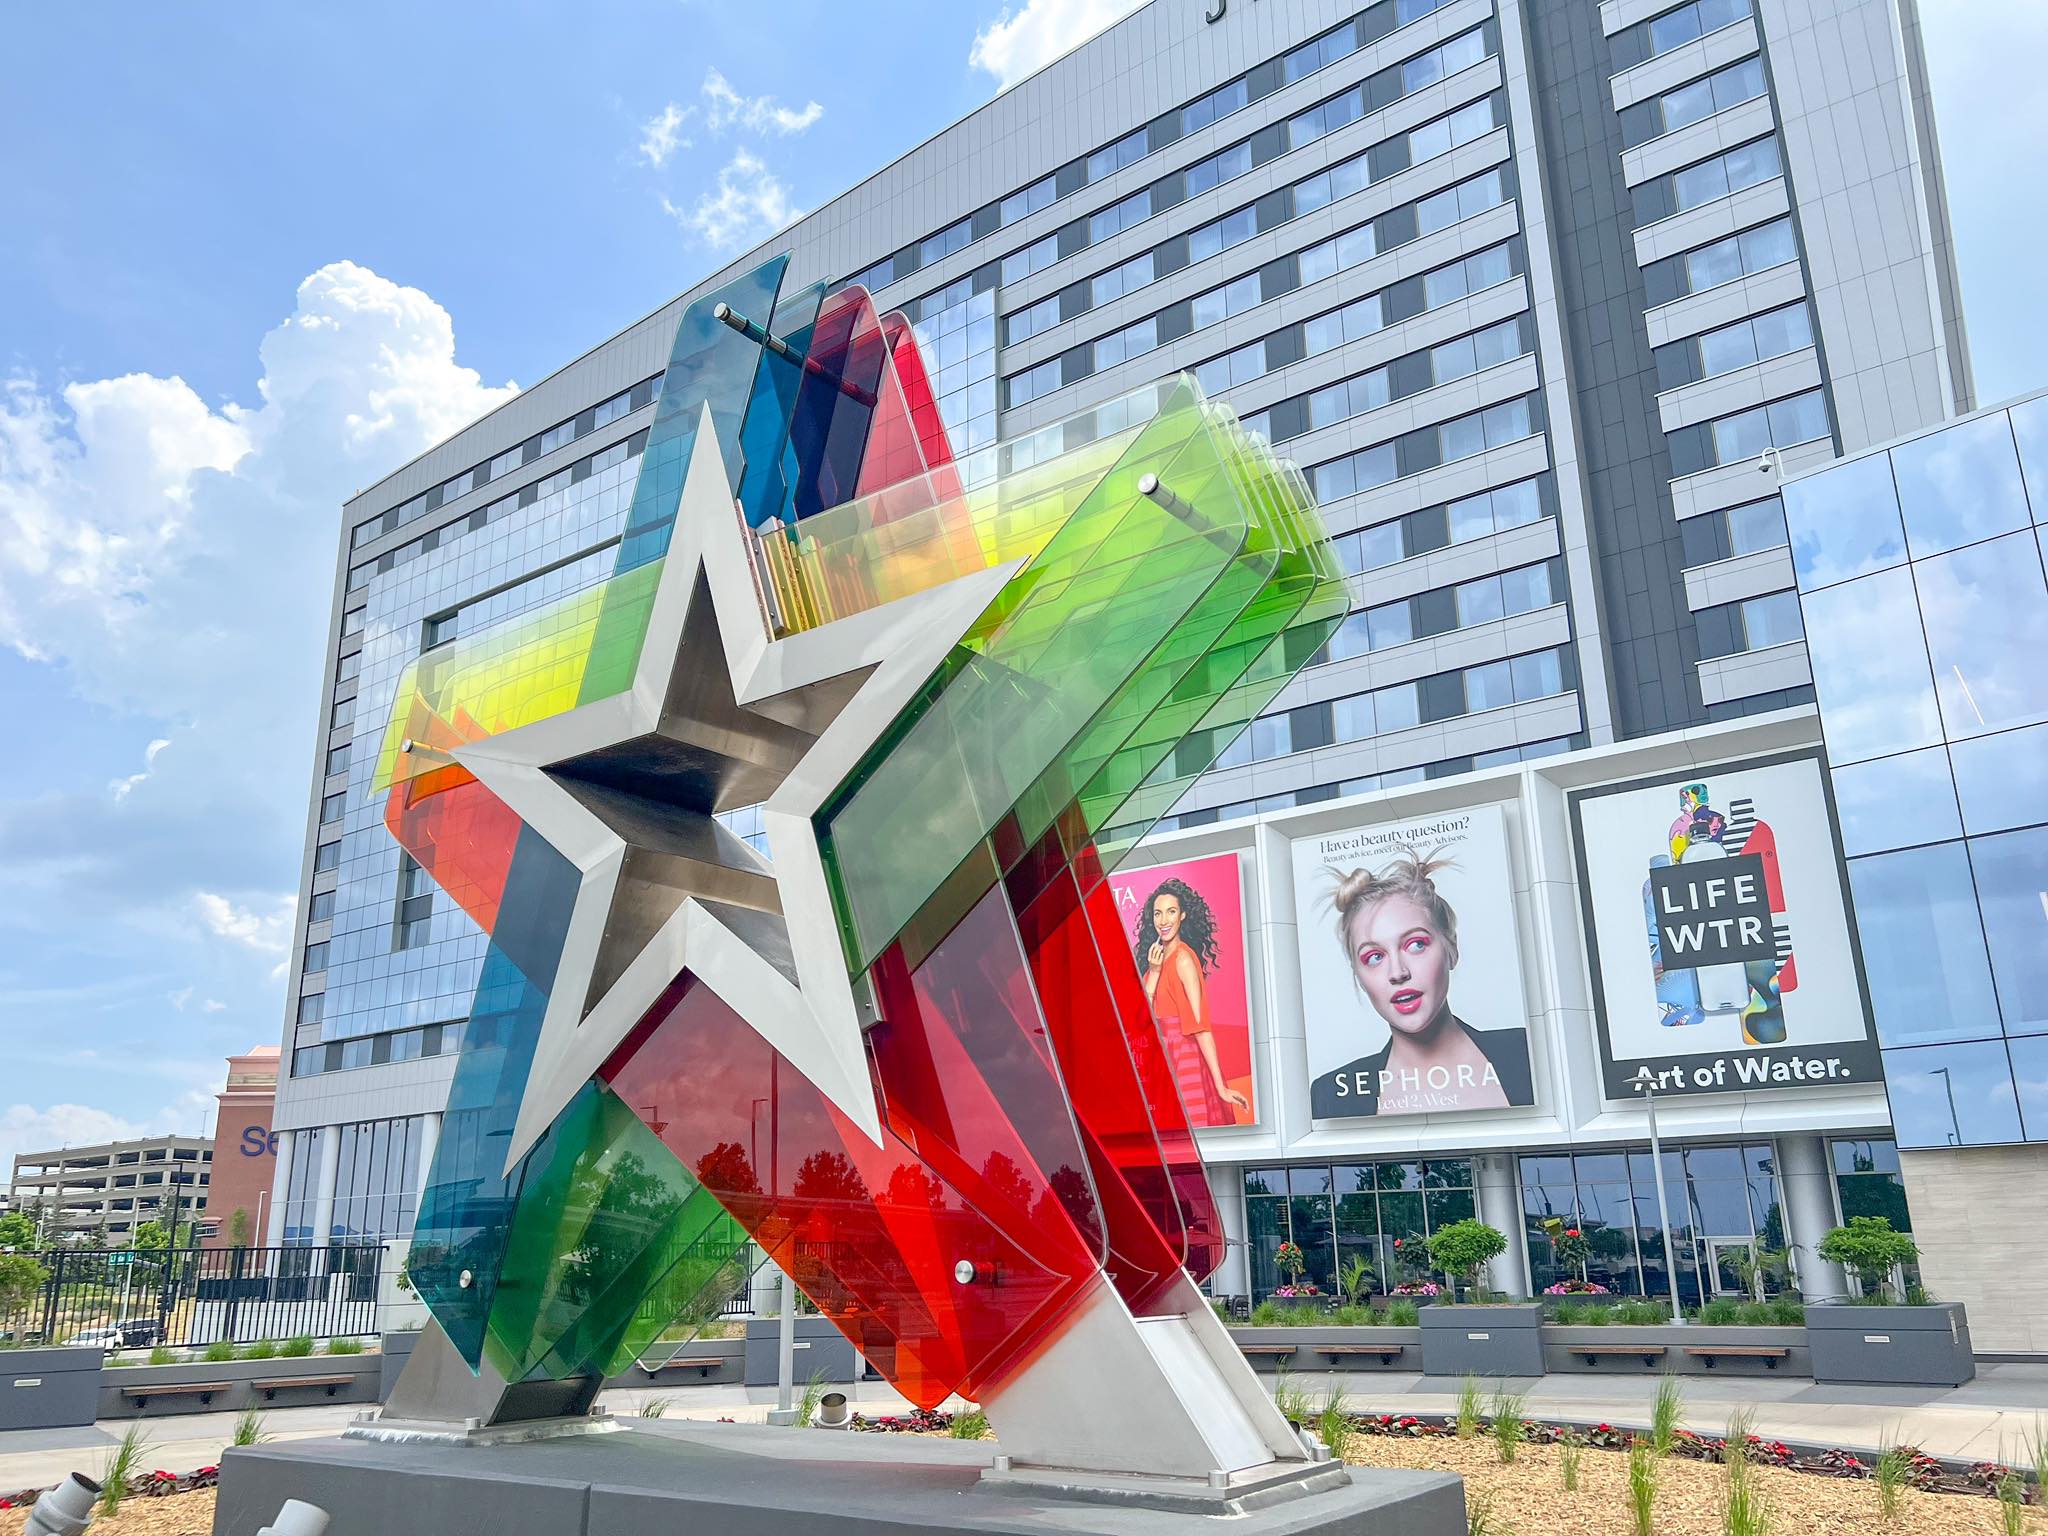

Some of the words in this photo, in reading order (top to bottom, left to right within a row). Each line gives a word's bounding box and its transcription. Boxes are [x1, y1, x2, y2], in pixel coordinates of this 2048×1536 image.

[1320, 839, 1350, 854] Have
[1351, 838, 1359, 848] a
[1361, 829, 1404, 847] beauty
[1406, 815, 1470, 840] question?
[1323, 853, 1347, 864] Beauty
[1348, 848, 1373, 859] advice,
[1374, 845, 1392, 855] meet
[1661, 874, 1758, 914] LIFE
[1664, 916, 1765, 954] WTR
[1335, 1061, 1501, 1097] SEPHORA
[1634, 1065, 1686, 1091] Art
[1693, 1059, 1726, 1087] of
[1732, 1056, 1851, 1084] Water.
[1377, 1095, 1409, 1110] Level
[1410, 1095, 1423, 1109] 2,
[1424, 1093, 1459, 1107] West
